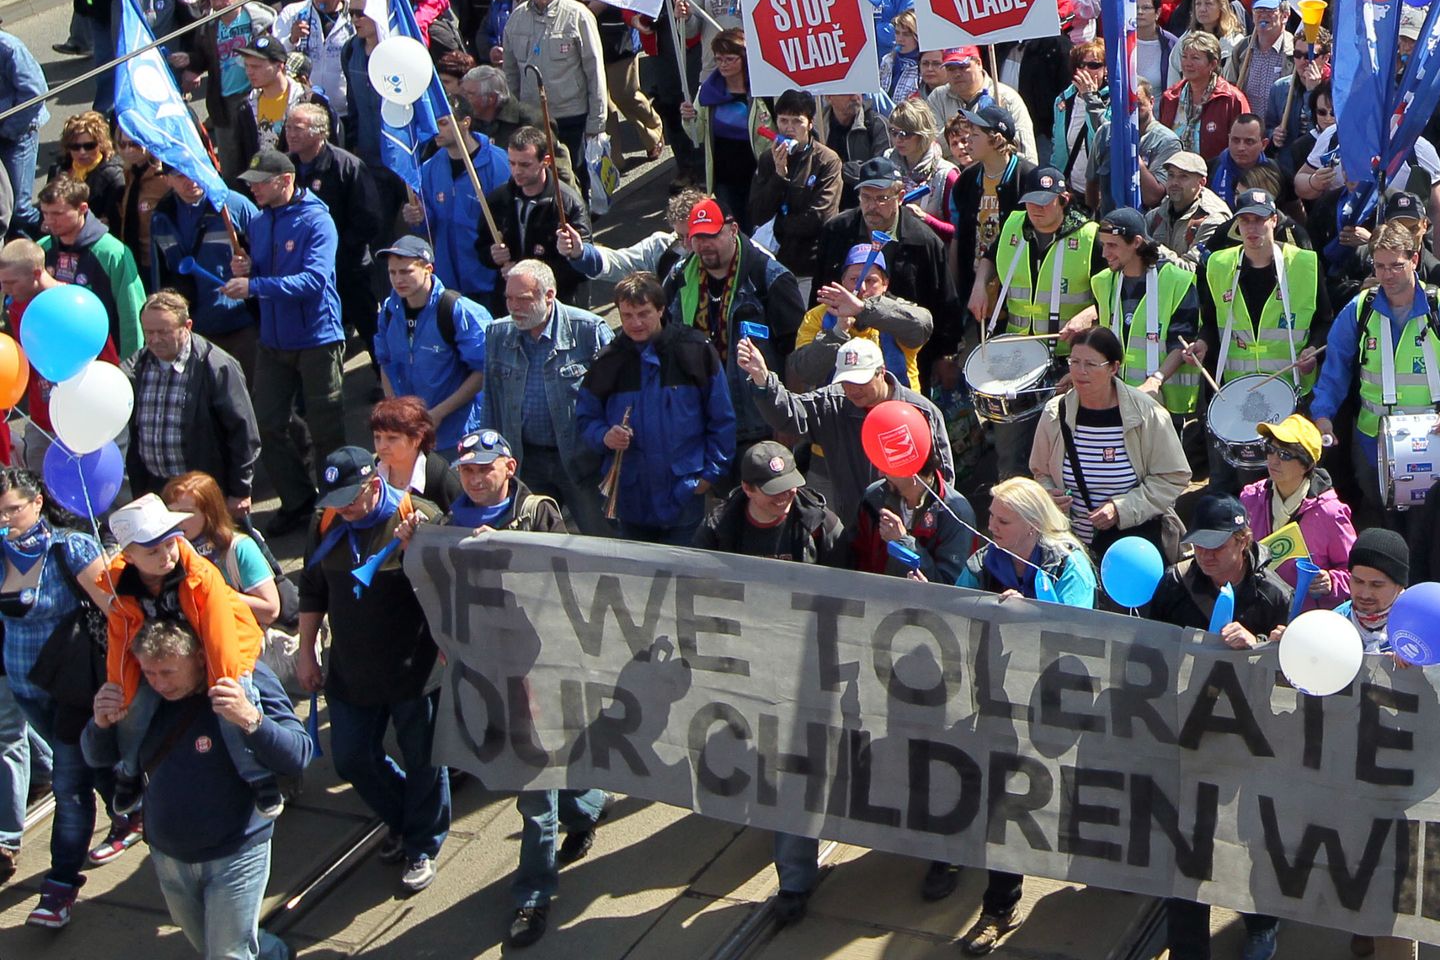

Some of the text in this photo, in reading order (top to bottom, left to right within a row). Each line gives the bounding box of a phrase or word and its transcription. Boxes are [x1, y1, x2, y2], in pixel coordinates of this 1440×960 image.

[779, 24, 850, 73] VLÁDĚ
[421, 546, 515, 643] IF
[551, 557, 750, 678] WE
[791, 591, 1418, 787] TOLERATE
[451, 659, 652, 778] OUR
[688, 702, 1218, 882] CHILDREN
